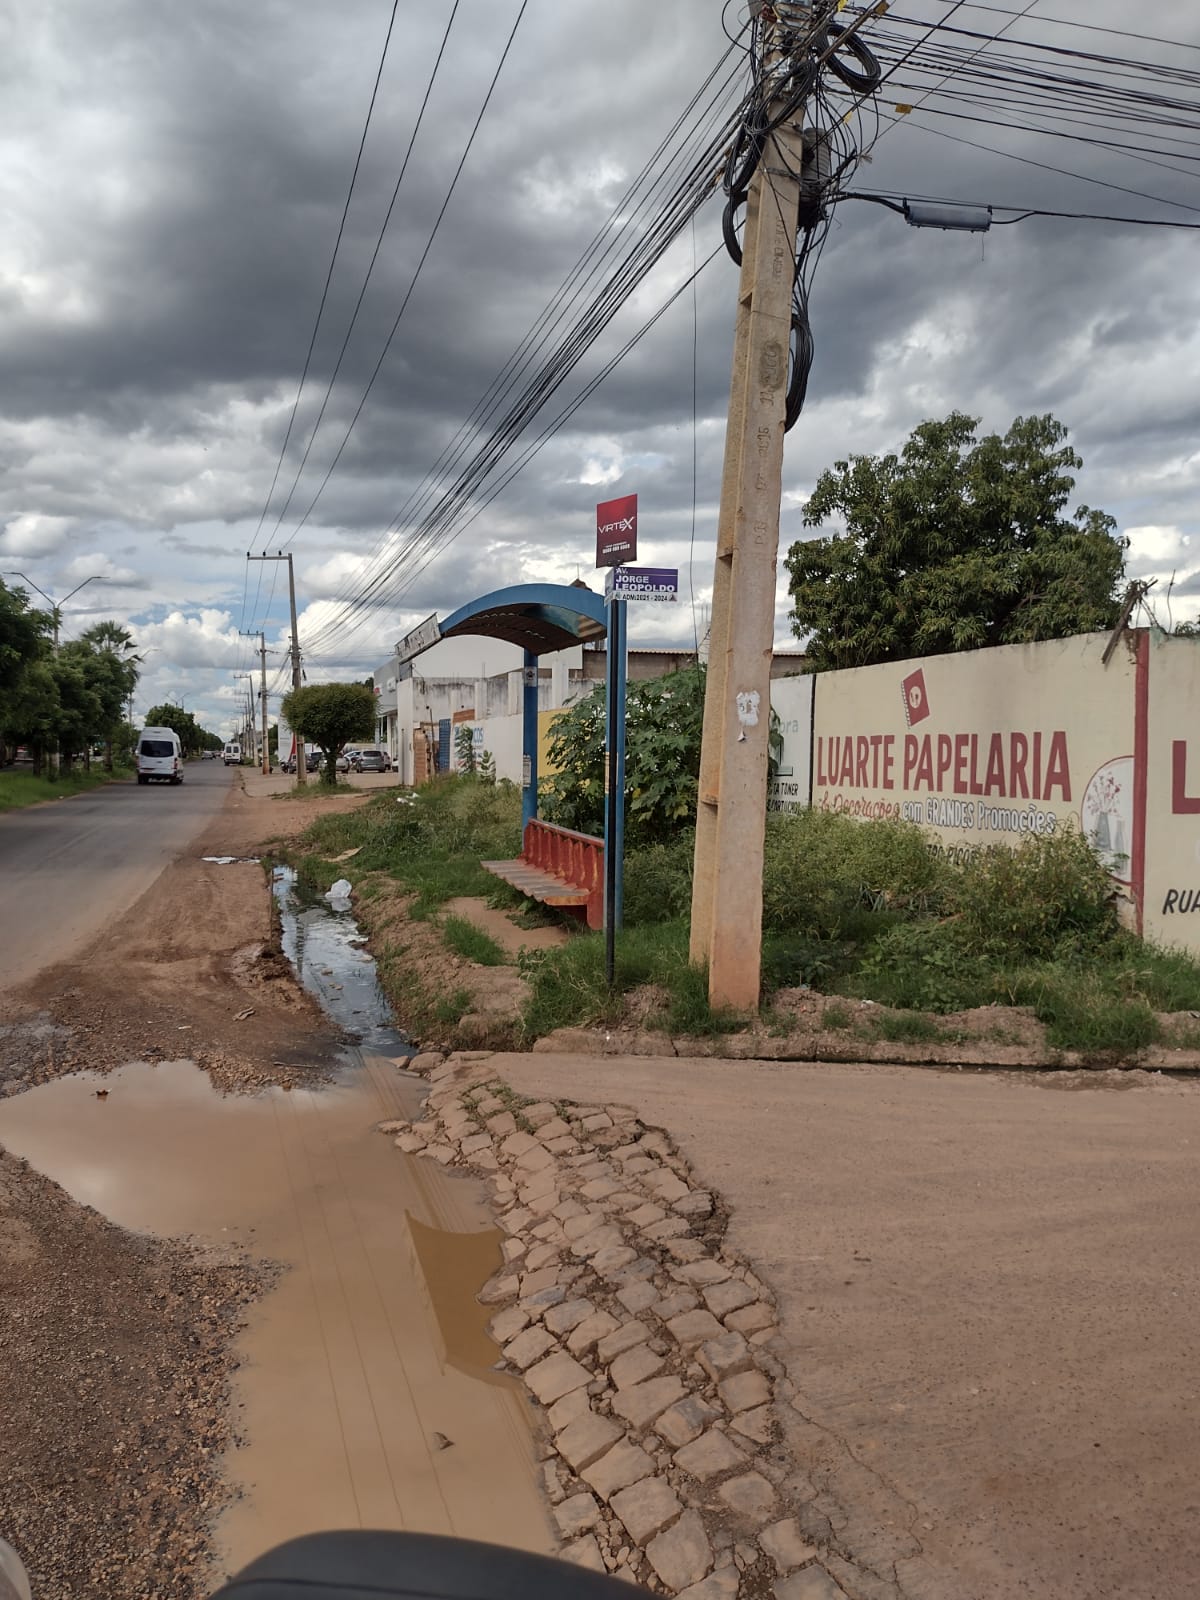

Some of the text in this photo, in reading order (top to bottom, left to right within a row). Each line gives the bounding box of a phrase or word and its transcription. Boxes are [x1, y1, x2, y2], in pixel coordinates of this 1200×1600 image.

[615, 575, 649, 584] JORGE
[615, 583, 676, 592] LEOPOLDO
[817, 731, 1072, 802] LUARTE PAPELARIA
[902, 801, 923, 825] com
[926, 797, 975, 829] GRANDES
[977, 800, 1057, 836] Promoções
